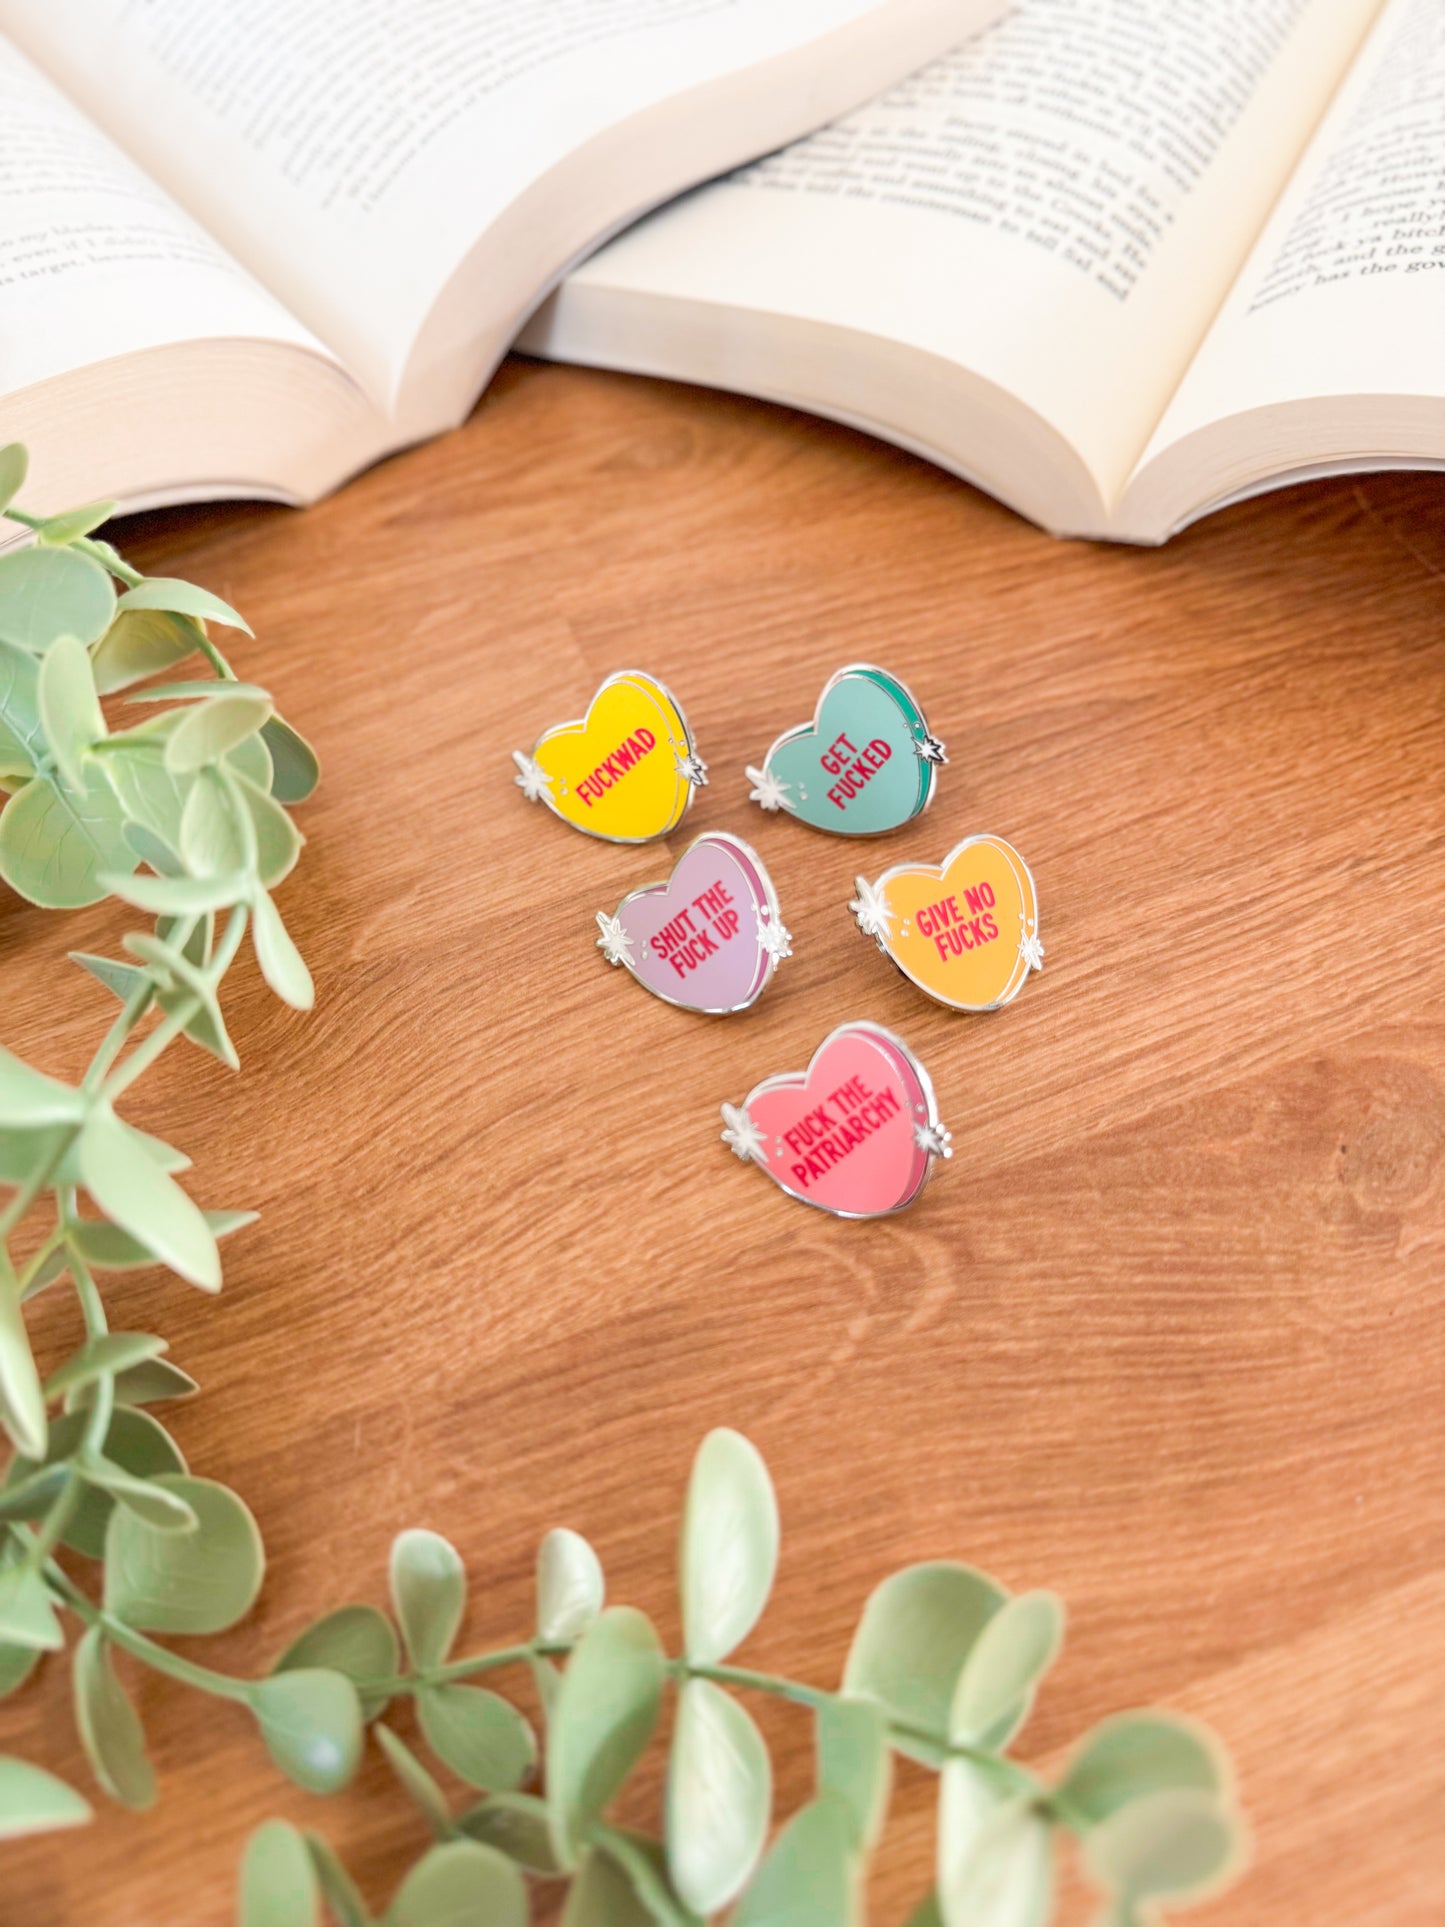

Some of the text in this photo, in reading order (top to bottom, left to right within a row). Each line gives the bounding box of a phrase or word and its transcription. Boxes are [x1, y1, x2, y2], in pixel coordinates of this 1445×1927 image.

[1314, 270, 1350, 286] has
[1359, 261, 1398, 276] the
[1333, 247, 1376, 266] and
[1386, 243, 1423, 257] the
[576, 728, 656, 807] FUCKWAD
[821, 733, 857, 774] GET
[828, 740, 892, 810] FUCKED
[651, 880, 734, 960] SHUT THE
[917, 882, 996, 937] GIVE NO
[934, 913, 999, 962] FUCKS
[669, 910, 739, 979] FUCK UP
[784, 1075, 874, 1154] FUCK THE
[791, 1087, 901, 1188] PATRIARCHY
